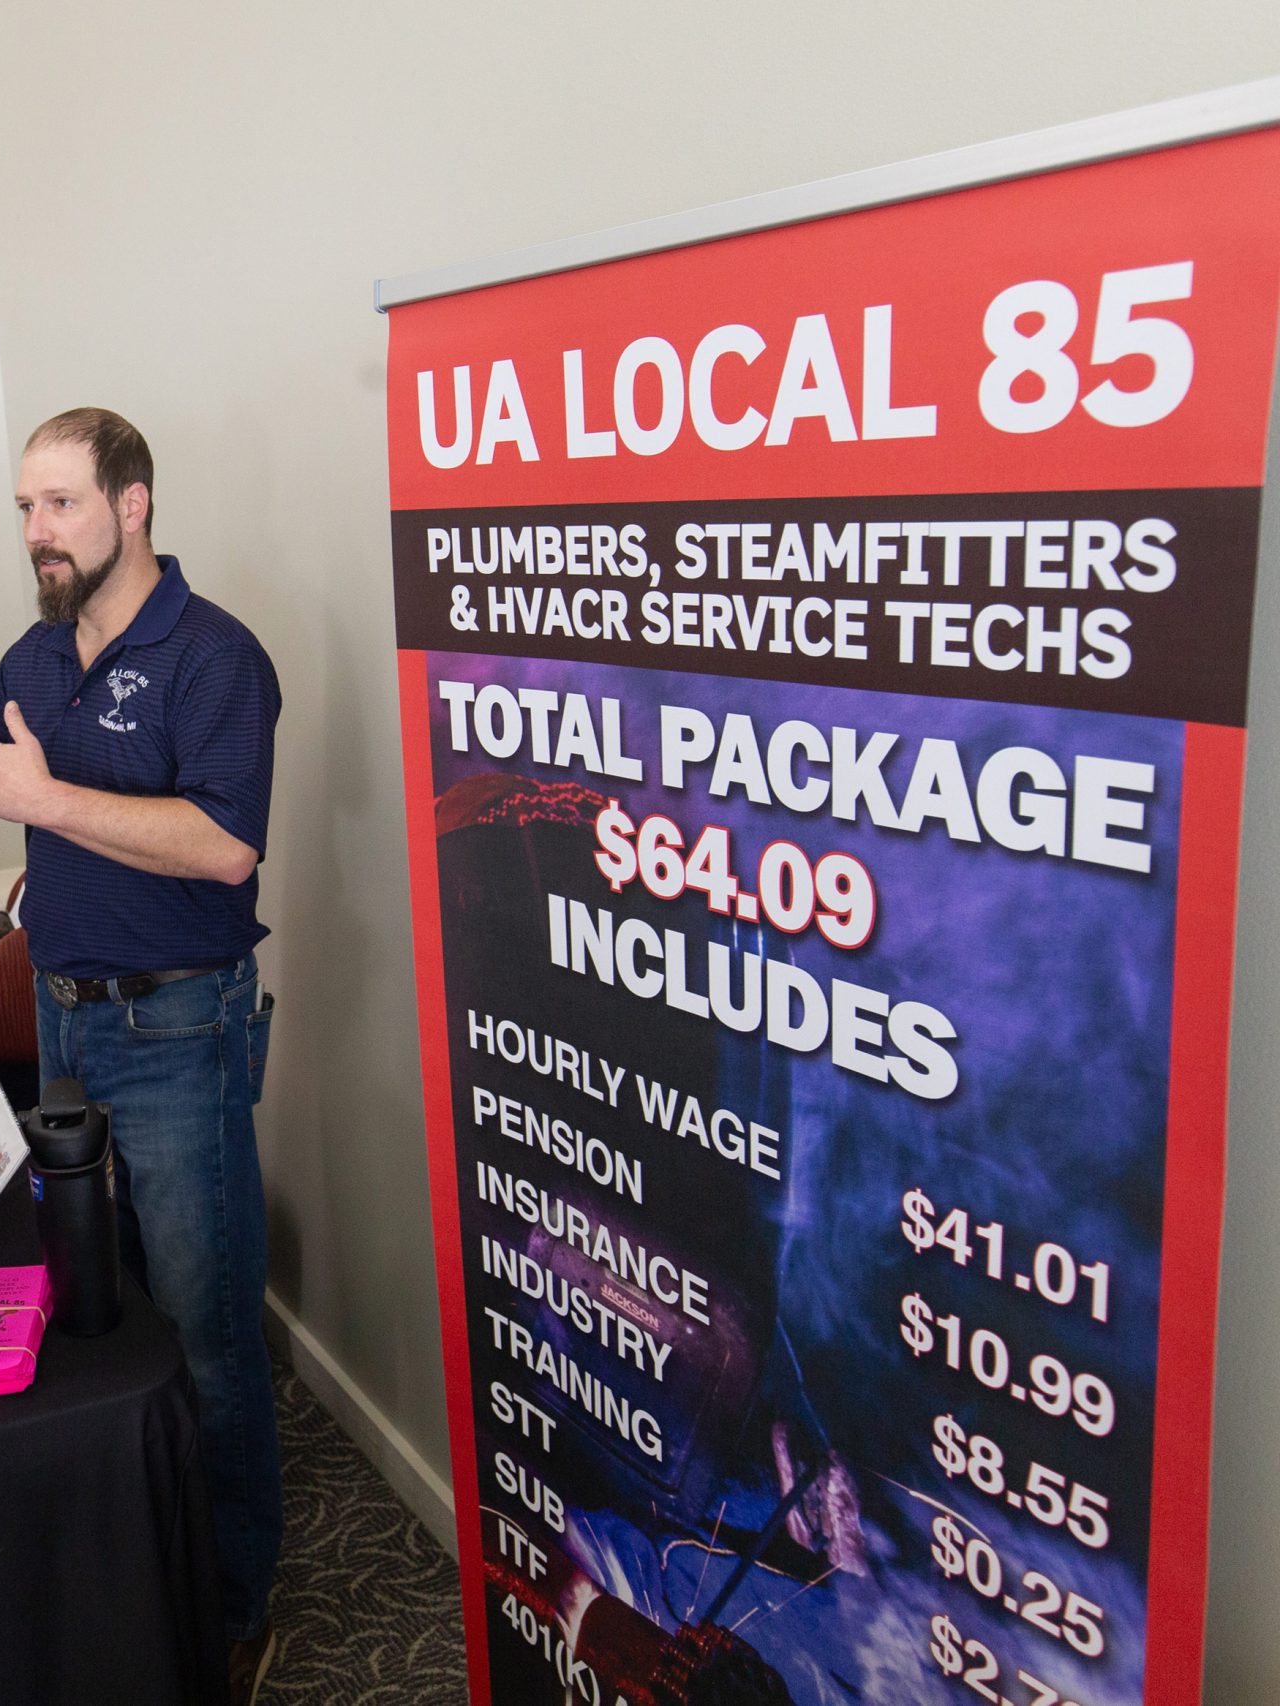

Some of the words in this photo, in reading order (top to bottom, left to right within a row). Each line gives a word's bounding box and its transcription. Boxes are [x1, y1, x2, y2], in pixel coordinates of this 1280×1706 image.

[417, 359, 540, 470] UA
[564, 304, 937, 460] LOCAL
[979, 261, 1194, 434] 85
[427, 524, 661, 586] PLUMBERS,
[675, 518, 1177, 593] STEAMFITTERS
[137, 675, 150, 688] 85
[449, 586, 478, 632] &
[488, 586, 631, 642] HVACR
[641, 590, 867, 661] SERVICE
[885, 600, 1132, 680] TECHS
[439, 681, 642, 781] TOTAL
[661, 706, 1155, 874] PACKAGE
[594, 799, 877, 950] $64.09
[548, 893, 959, 1100] INCLUDES
[468, 1009, 625, 1108] HOURLY
[636, 1074, 780, 1180] WAGE
[473, 1086, 642, 1204] PENSION
[477, 1161, 710, 1326] INSURANCE
[481, 1235, 672, 1382] INDUSTRY
[601, 1284, 659, 1328] JACKSON
[901, 1187, 1109, 1323] $41.01
[484, 1306, 663, 1462] TRAINING
[490, 1381, 557, 1453] STT
[900, 1292, 1115, 1437] $10.99
[495, 1451, 567, 1534] SUB
[932, 1413, 1109, 1548] $8.55
[498, 1518, 548, 1581] ITF
[931, 1515, 1105, 1657] $0.25
[501, 1593, 600, 1706] 401(K)
[930, 1614, 1084, 1706] $2.7
